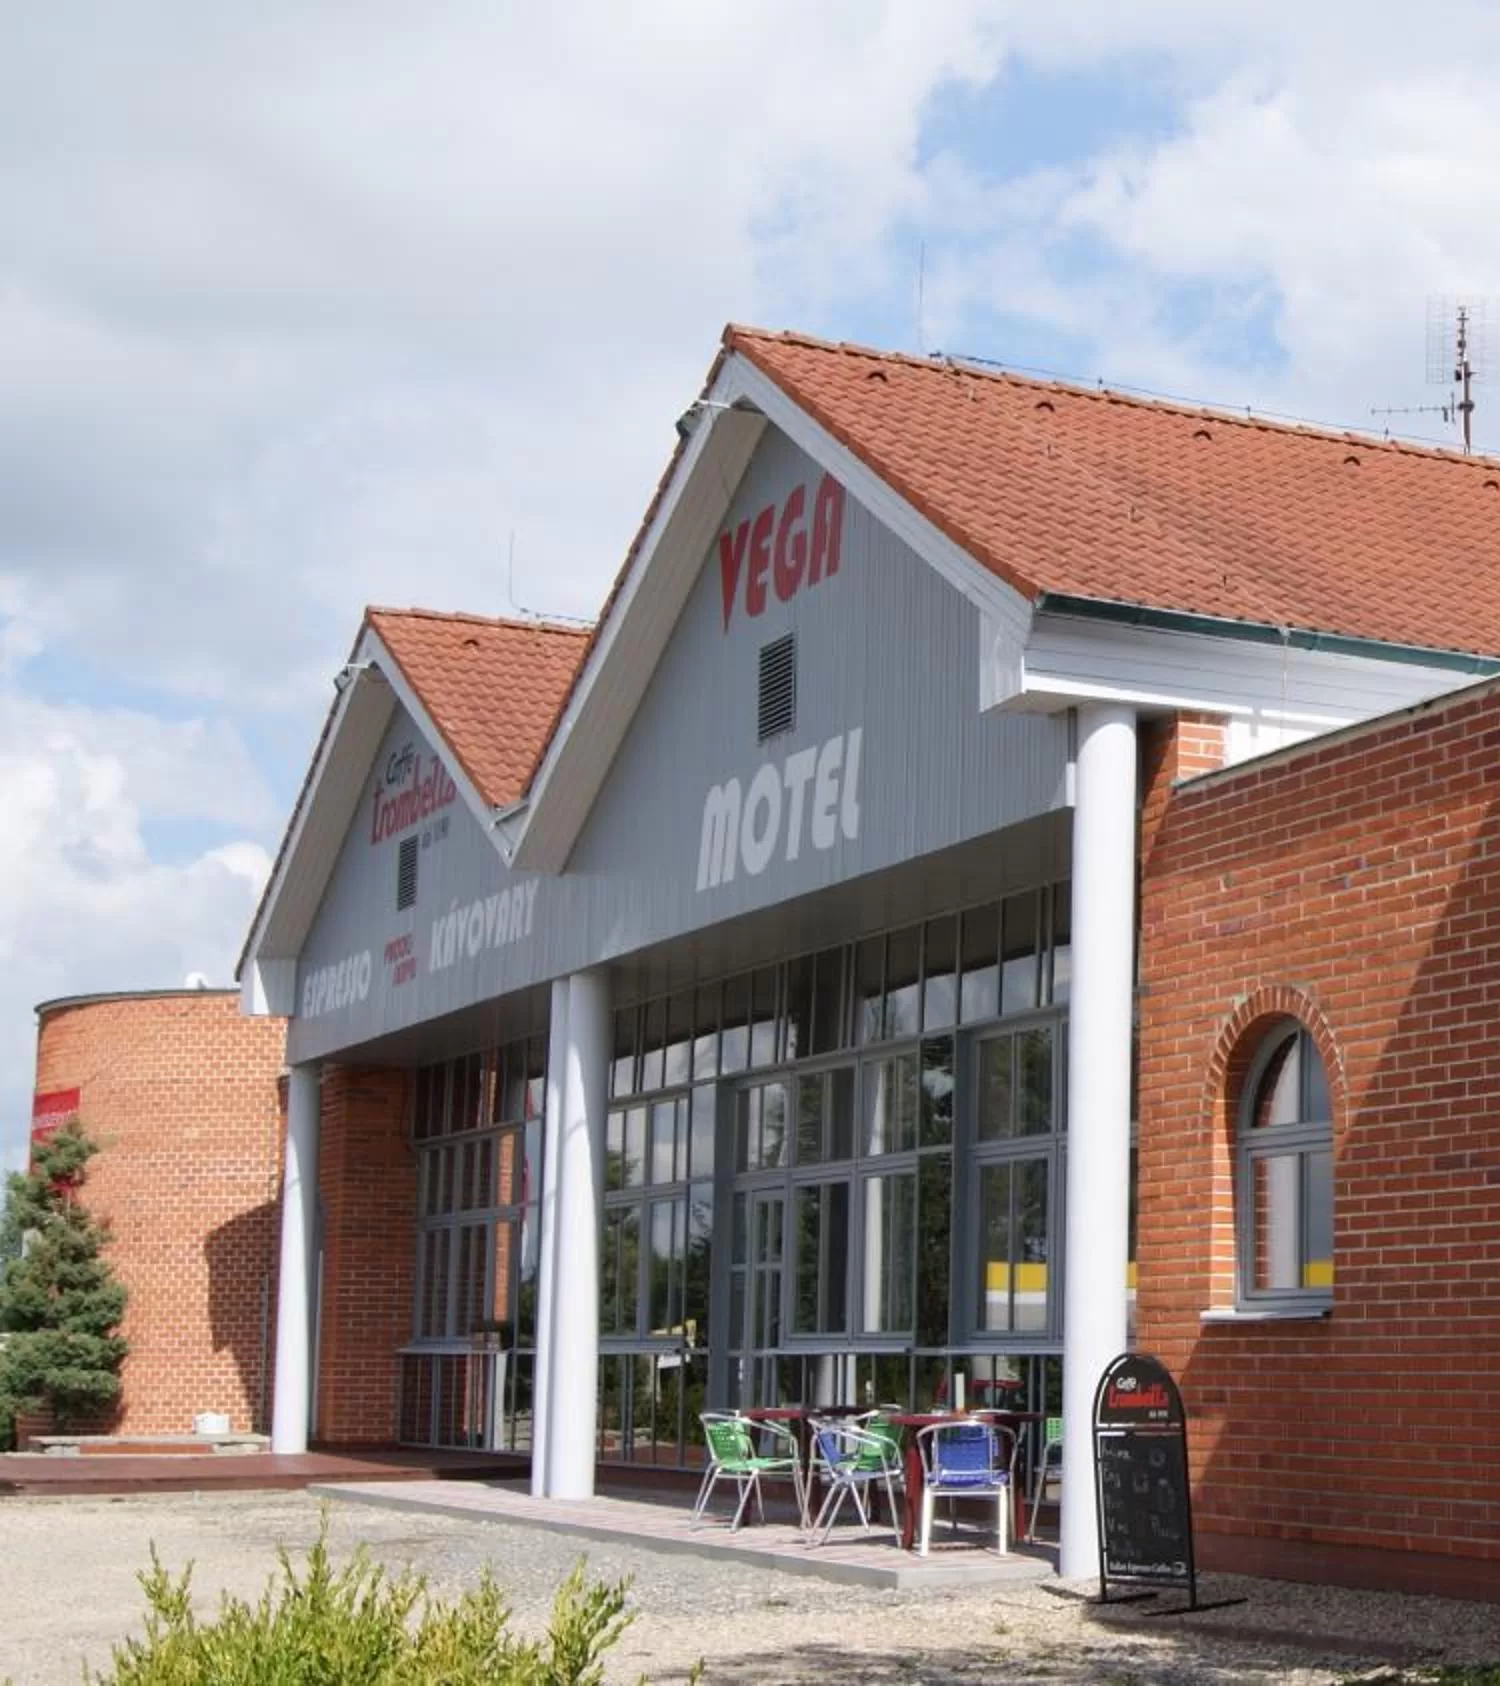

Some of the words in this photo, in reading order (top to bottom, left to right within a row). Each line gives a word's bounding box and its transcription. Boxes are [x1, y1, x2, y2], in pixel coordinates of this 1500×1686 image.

[720, 472, 846, 634] VEGA
[696, 727, 863, 891] MOTEL
[302, 950, 372, 1019] ESPRESSO
